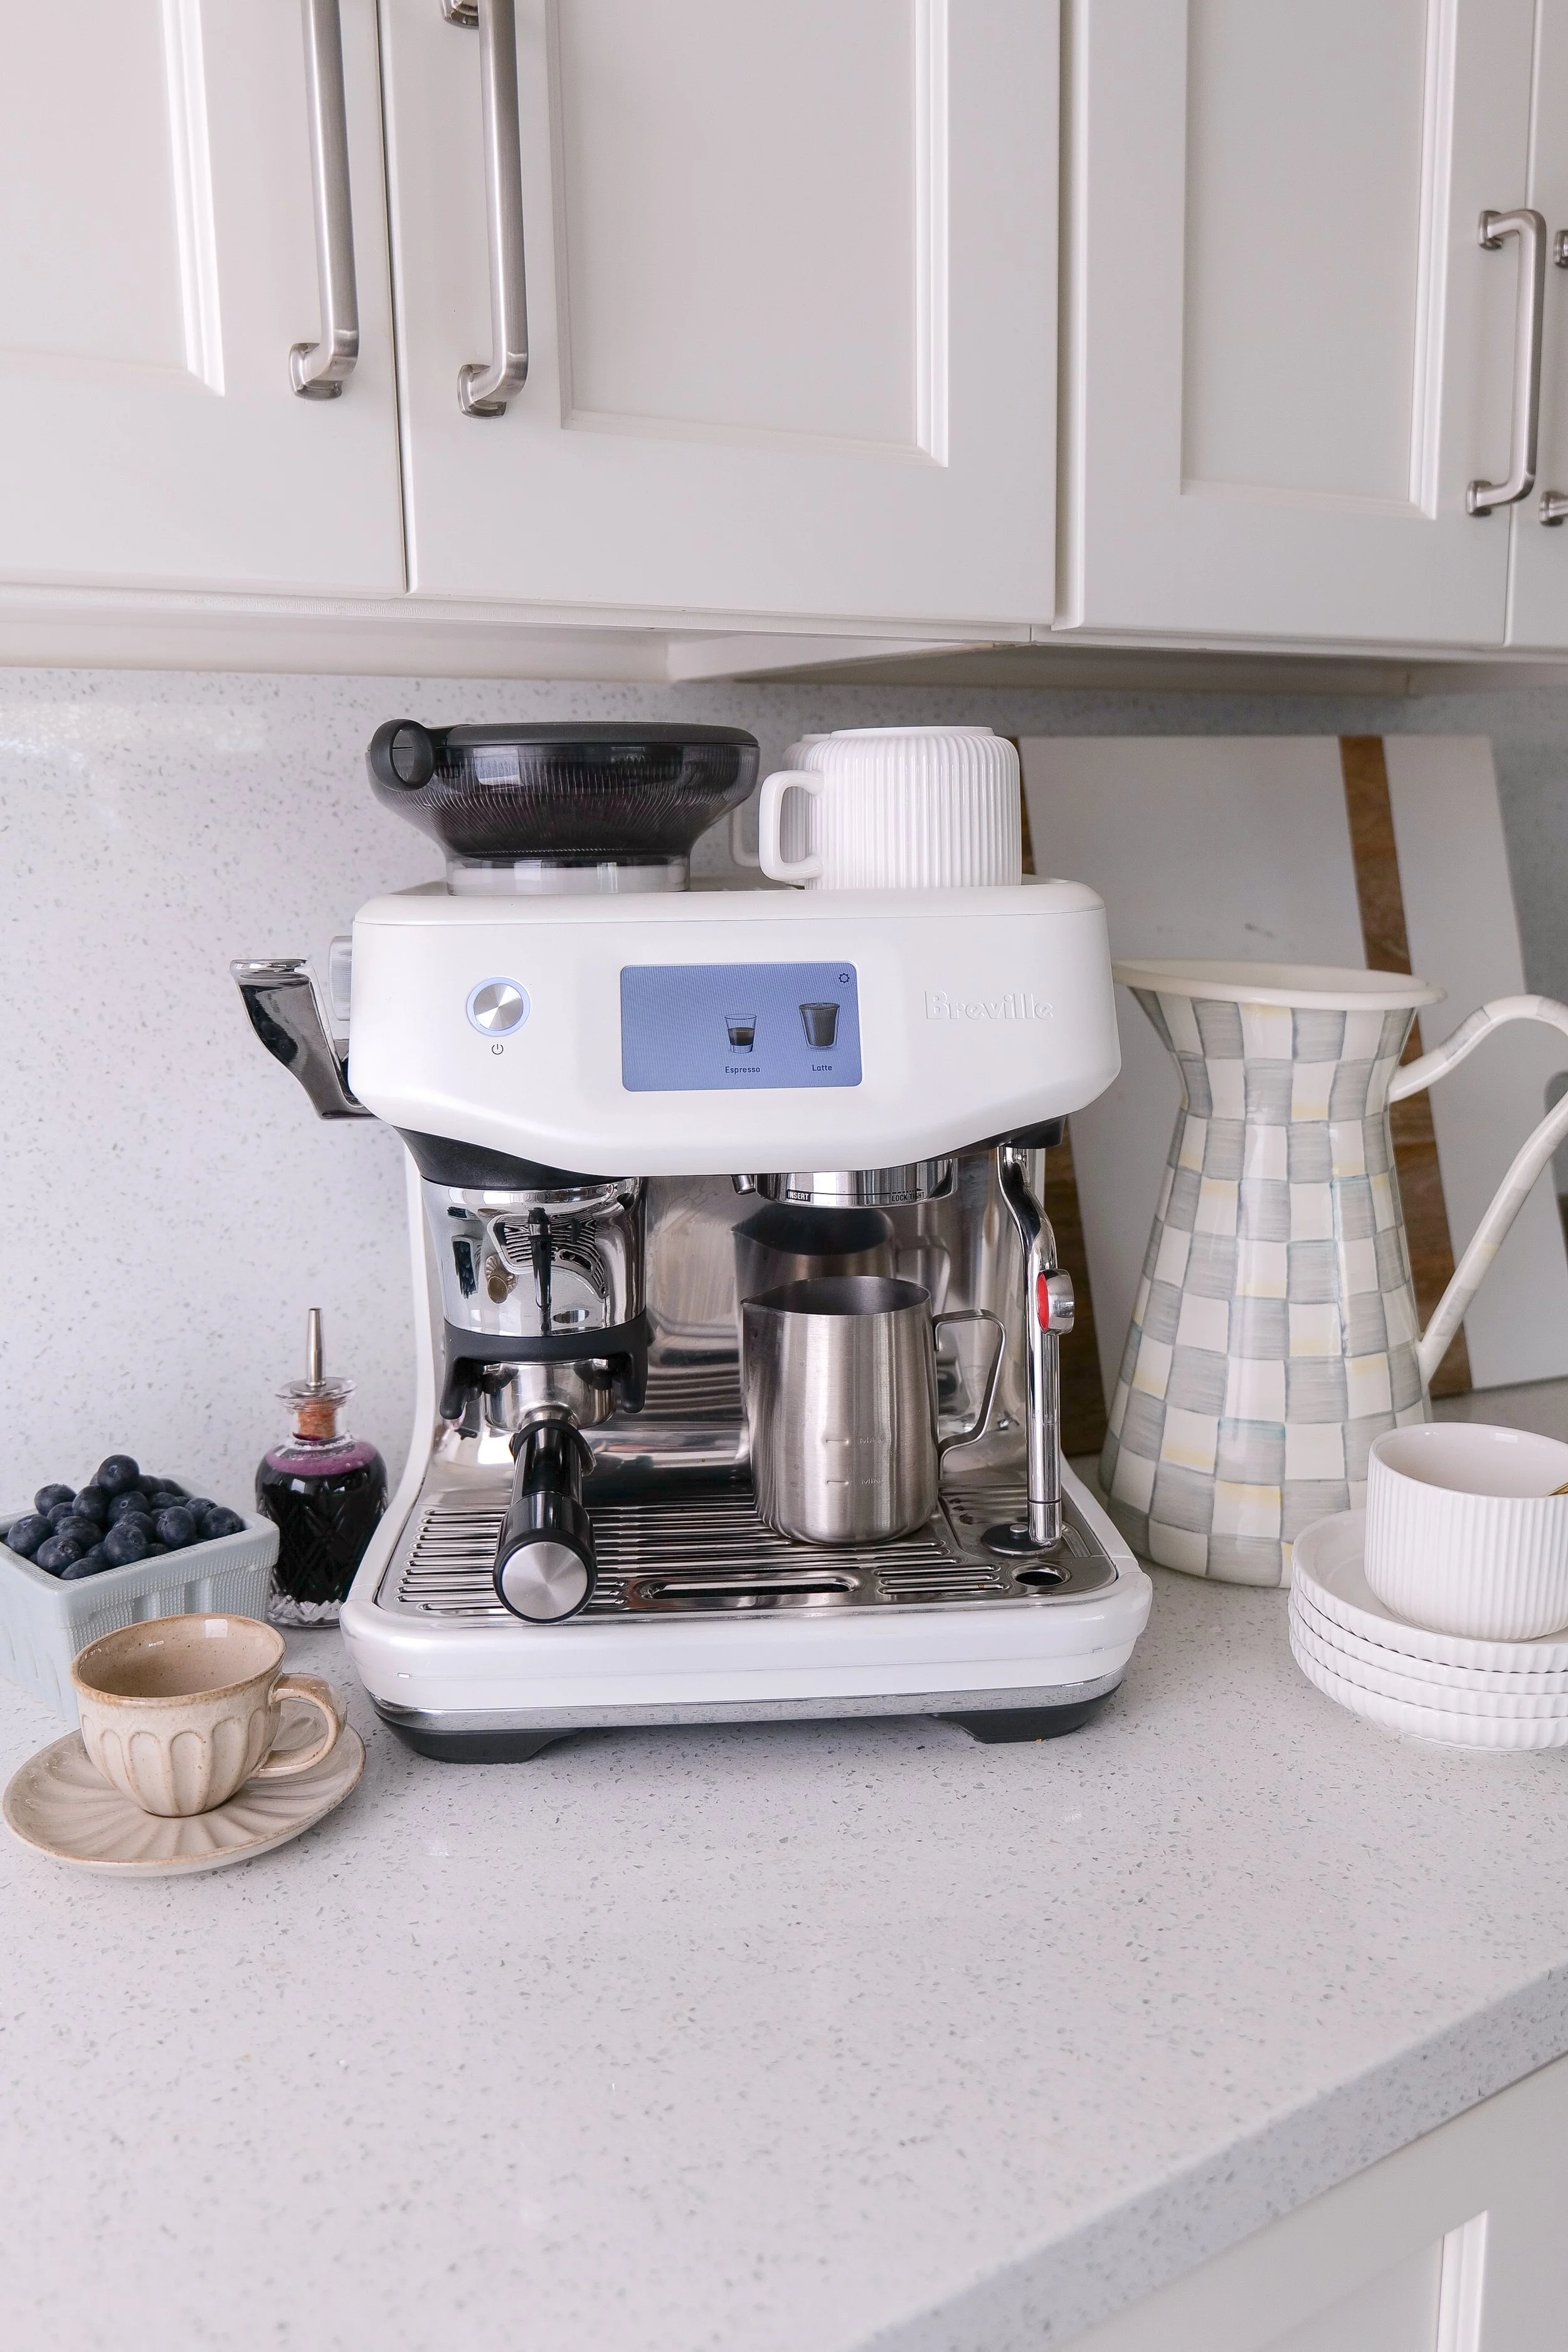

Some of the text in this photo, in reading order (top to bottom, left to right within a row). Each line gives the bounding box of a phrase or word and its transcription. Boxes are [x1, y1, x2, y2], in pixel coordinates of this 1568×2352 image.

[924, 990, 1053, 1020] Breville
[725, 1066, 760, 1074] Espresso
[788, 1191, 808, 1200] INSERT
[892, 1192, 924, 1202] LOCK TIGHT
[860, 1435, 883, 1444] MAX
[861, 1476, 881, 1485] MIN
